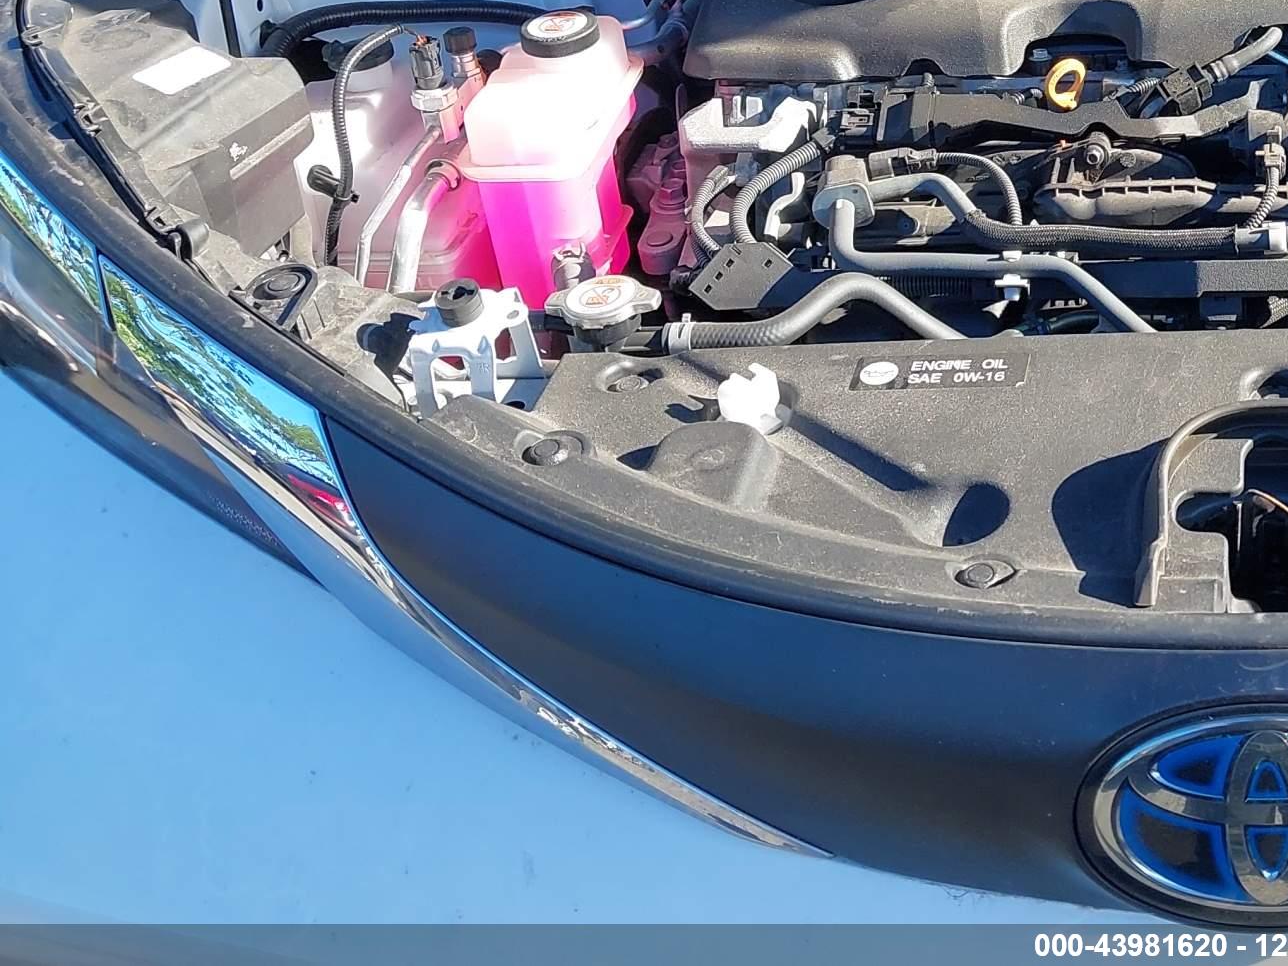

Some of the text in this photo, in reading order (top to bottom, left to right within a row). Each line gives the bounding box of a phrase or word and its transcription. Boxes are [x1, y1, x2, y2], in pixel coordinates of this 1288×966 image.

[911, 359, 1008, 371] ENGINE OIL
[908, 371, 1005, 384] SAE 0W-16
